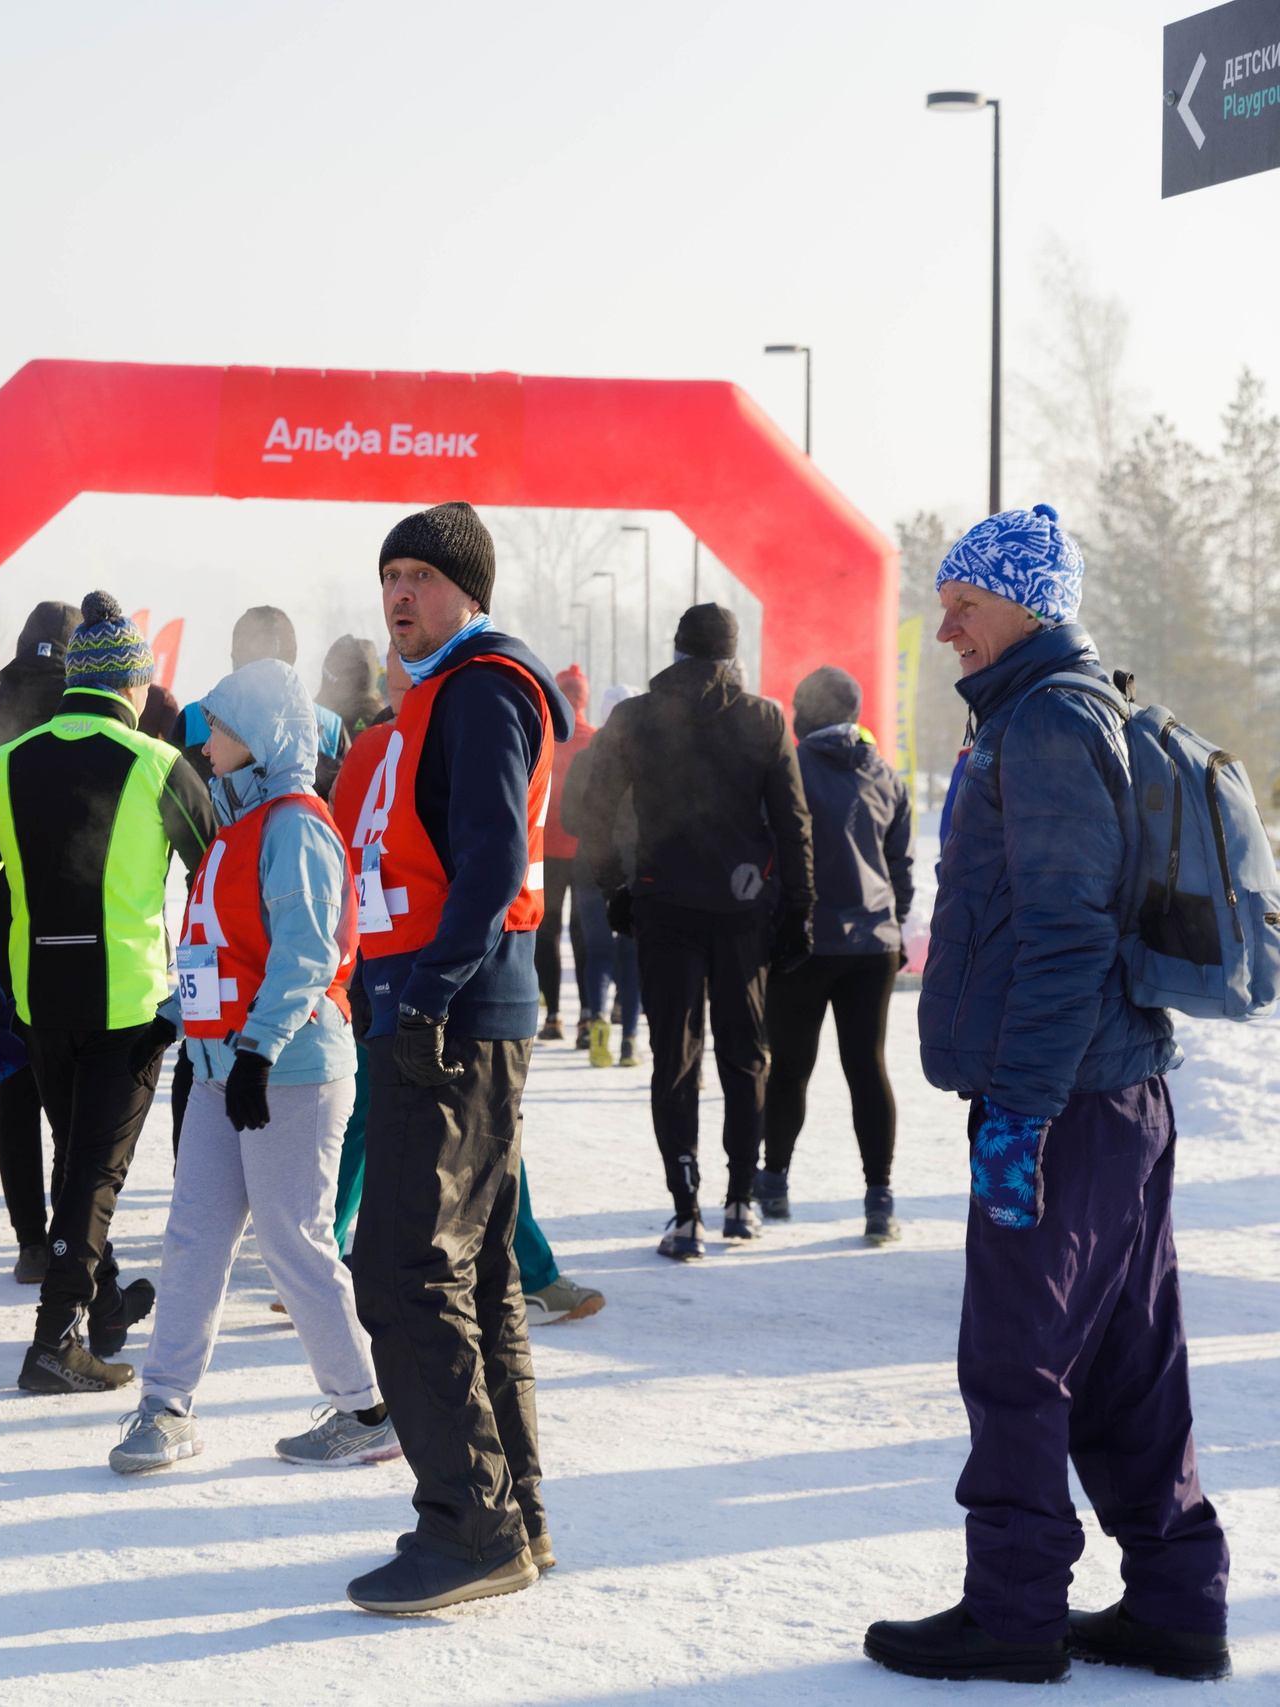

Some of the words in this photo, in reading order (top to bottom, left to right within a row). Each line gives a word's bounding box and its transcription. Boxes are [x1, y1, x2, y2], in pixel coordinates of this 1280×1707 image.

[262, 417, 382, 463] Альфа
[388, 423, 478, 458] Банк
[179, 973, 198, 999] 85
